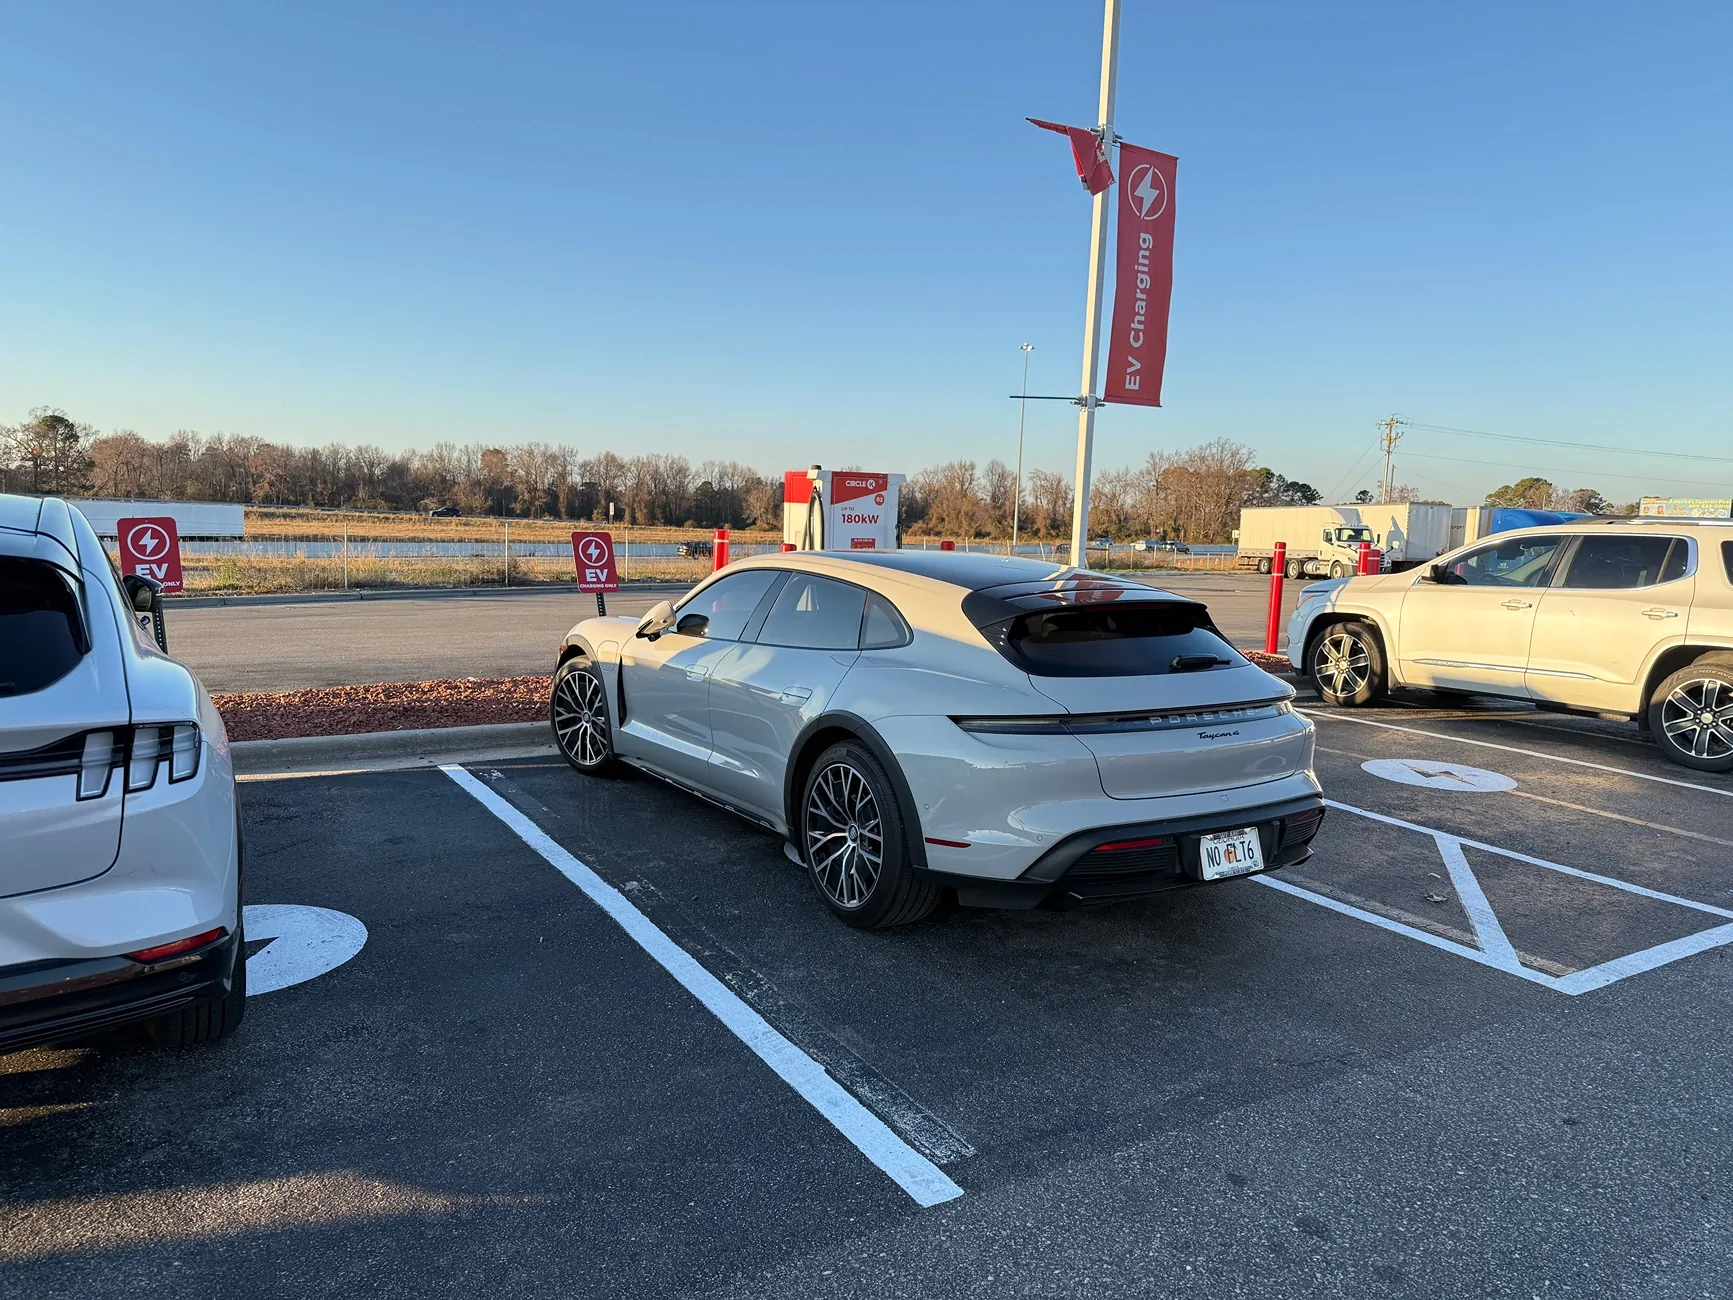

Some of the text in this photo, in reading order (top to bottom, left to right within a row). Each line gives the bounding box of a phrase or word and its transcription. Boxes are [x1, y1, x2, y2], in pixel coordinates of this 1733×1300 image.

[1125, 232, 1153, 391] EV Charging
[841, 514, 879, 524] 180kW
[135, 563, 168, 579] EV
[585, 568, 608, 582] EV
[1149, 708, 1257, 725] PORSCHE
[1197, 731, 1232, 740] Taycan
[1206, 845, 1222, 868] NO
